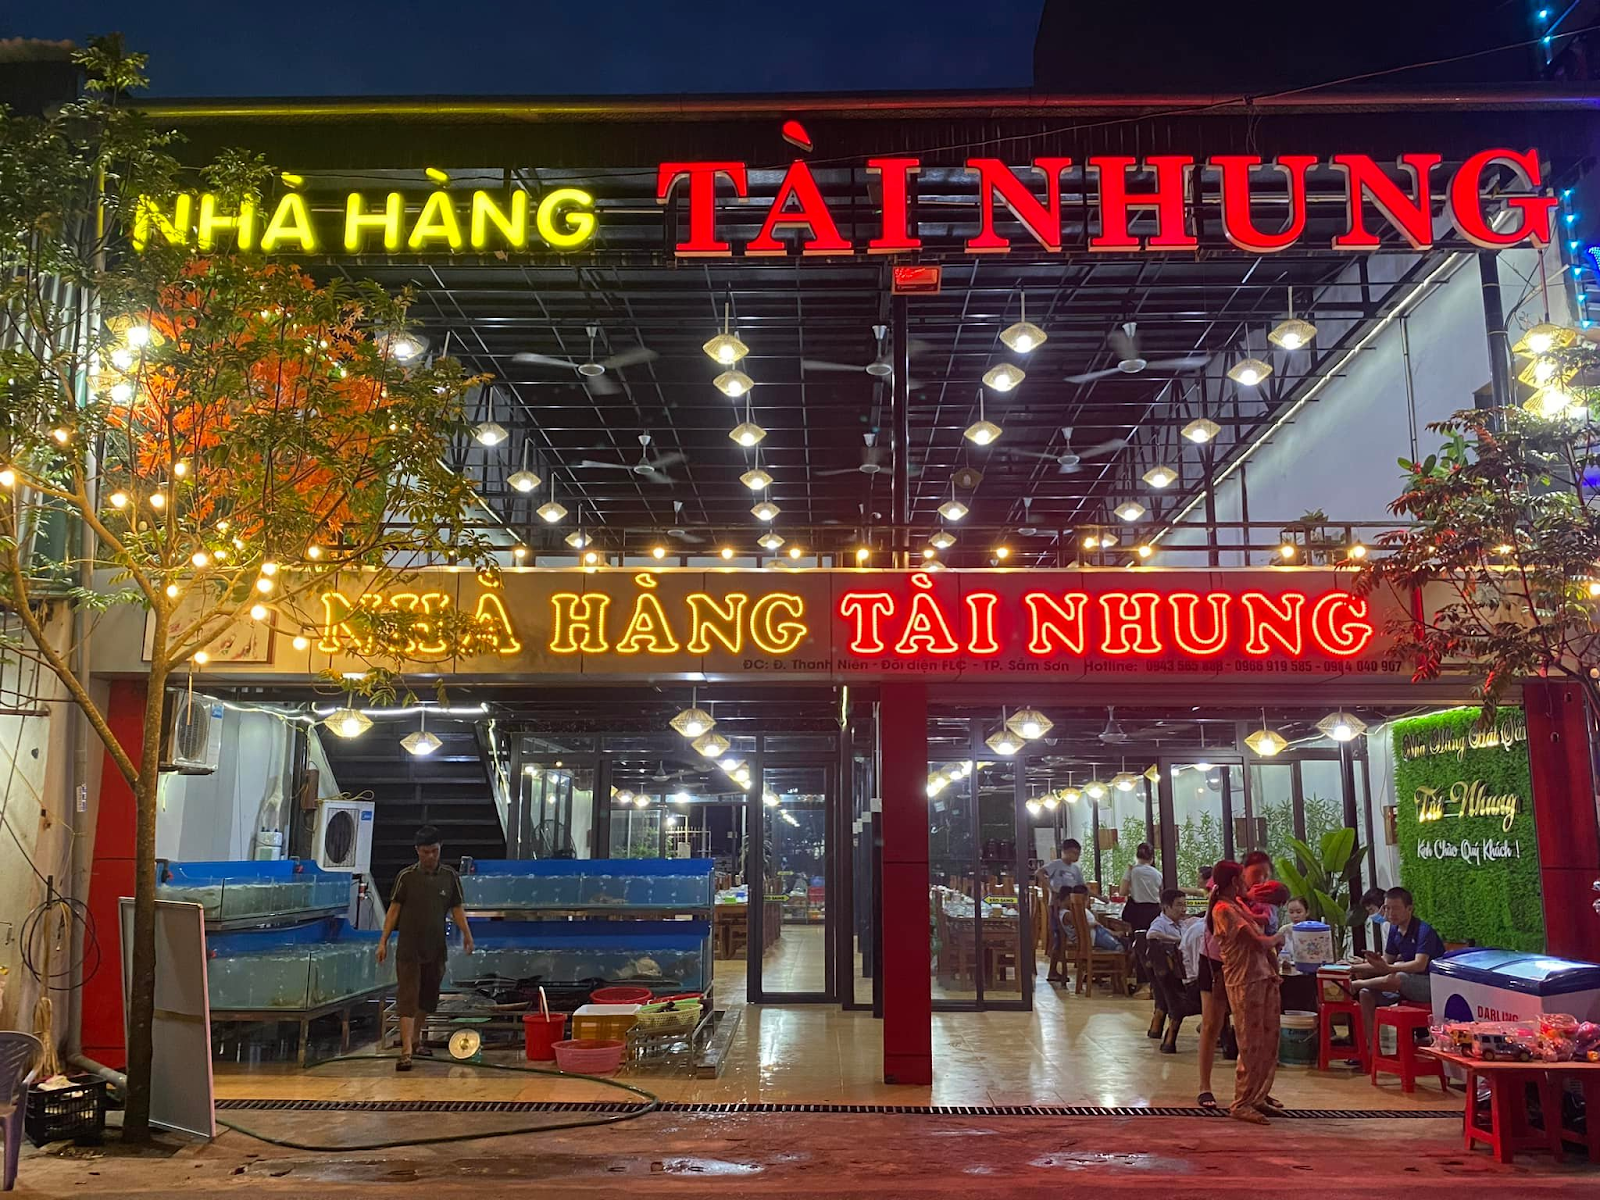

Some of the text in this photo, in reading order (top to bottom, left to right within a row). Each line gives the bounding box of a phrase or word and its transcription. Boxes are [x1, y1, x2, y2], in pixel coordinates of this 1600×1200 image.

[132, 119, 1559, 257] NHÀ HÀNG TÀI NHUNG
[550, 572, 808, 654] HÀNG
[840, 573, 1000, 655] TÀI
[1024, 591, 1374, 656] NHUNG
[743, 660, 769, 670] ĐC:
[773, 660, 786, 670] Đ.
[791, 659, 832, 670] Thanh
[983, 661, 1002, 671] TP.
[1043, 659, 1069, 672] Sơn
[1085, 660, 1138, 672] Hotline:
[1266, 660, 1288, 672] 919
[1356, 660, 1378, 672] 040
[1381, 660, 1402, 672] 907
